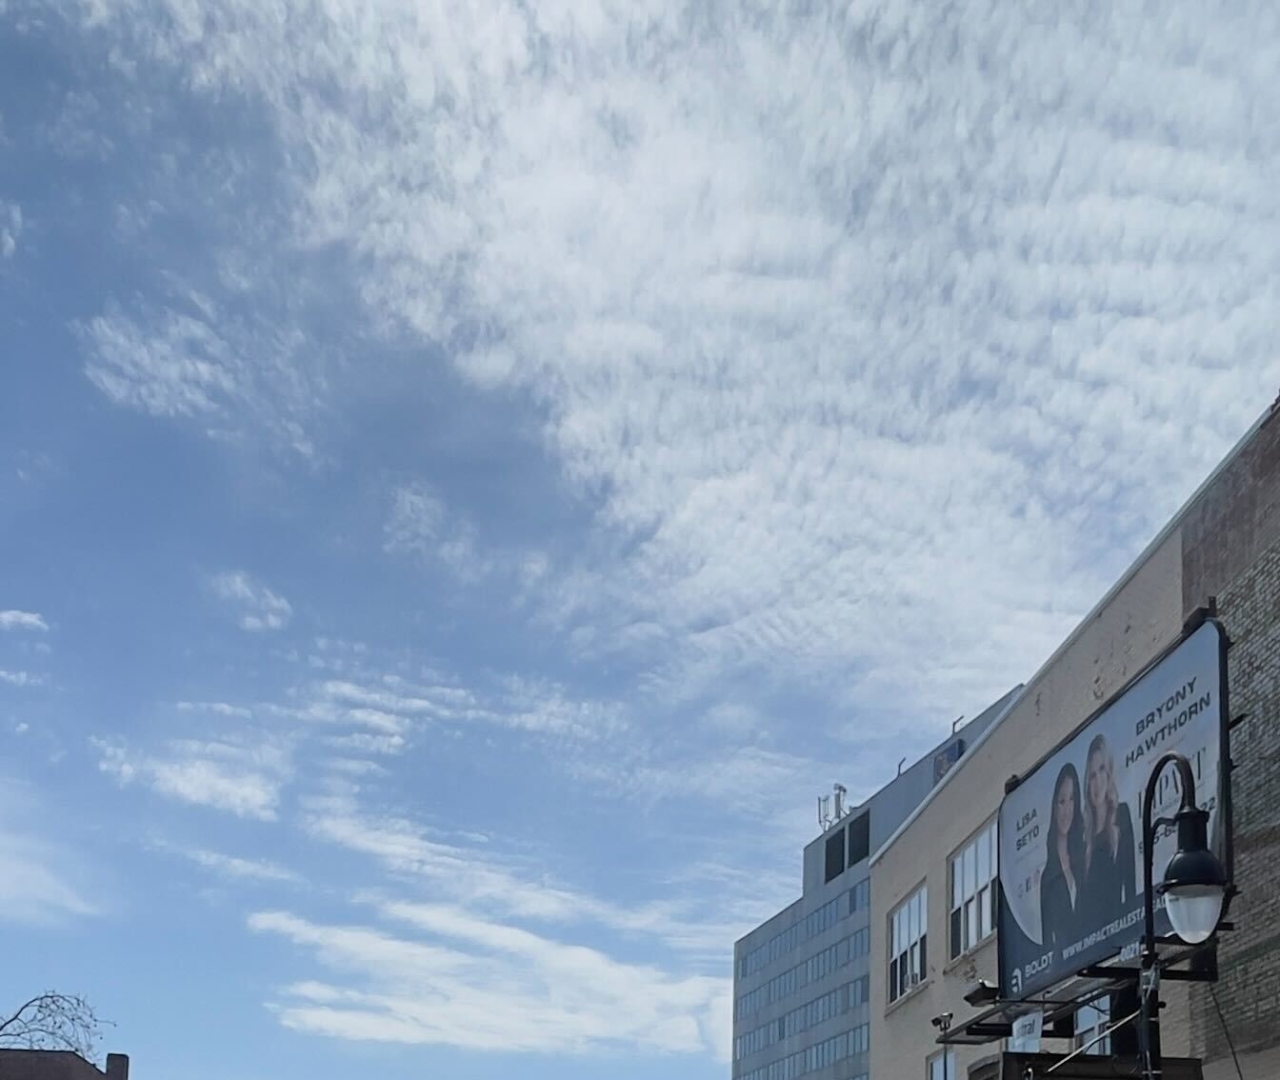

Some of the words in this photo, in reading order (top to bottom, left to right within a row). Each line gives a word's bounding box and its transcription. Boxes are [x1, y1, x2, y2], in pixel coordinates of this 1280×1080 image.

[1136, 677, 1197, 736] BRYONY
[1125, 692, 1211, 768] HAWTHORN
[1016, 808, 1037, 832] LISA
[1016, 825, 1040, 851] SETO
[1025, 951, 1053, 978] BOLDT
